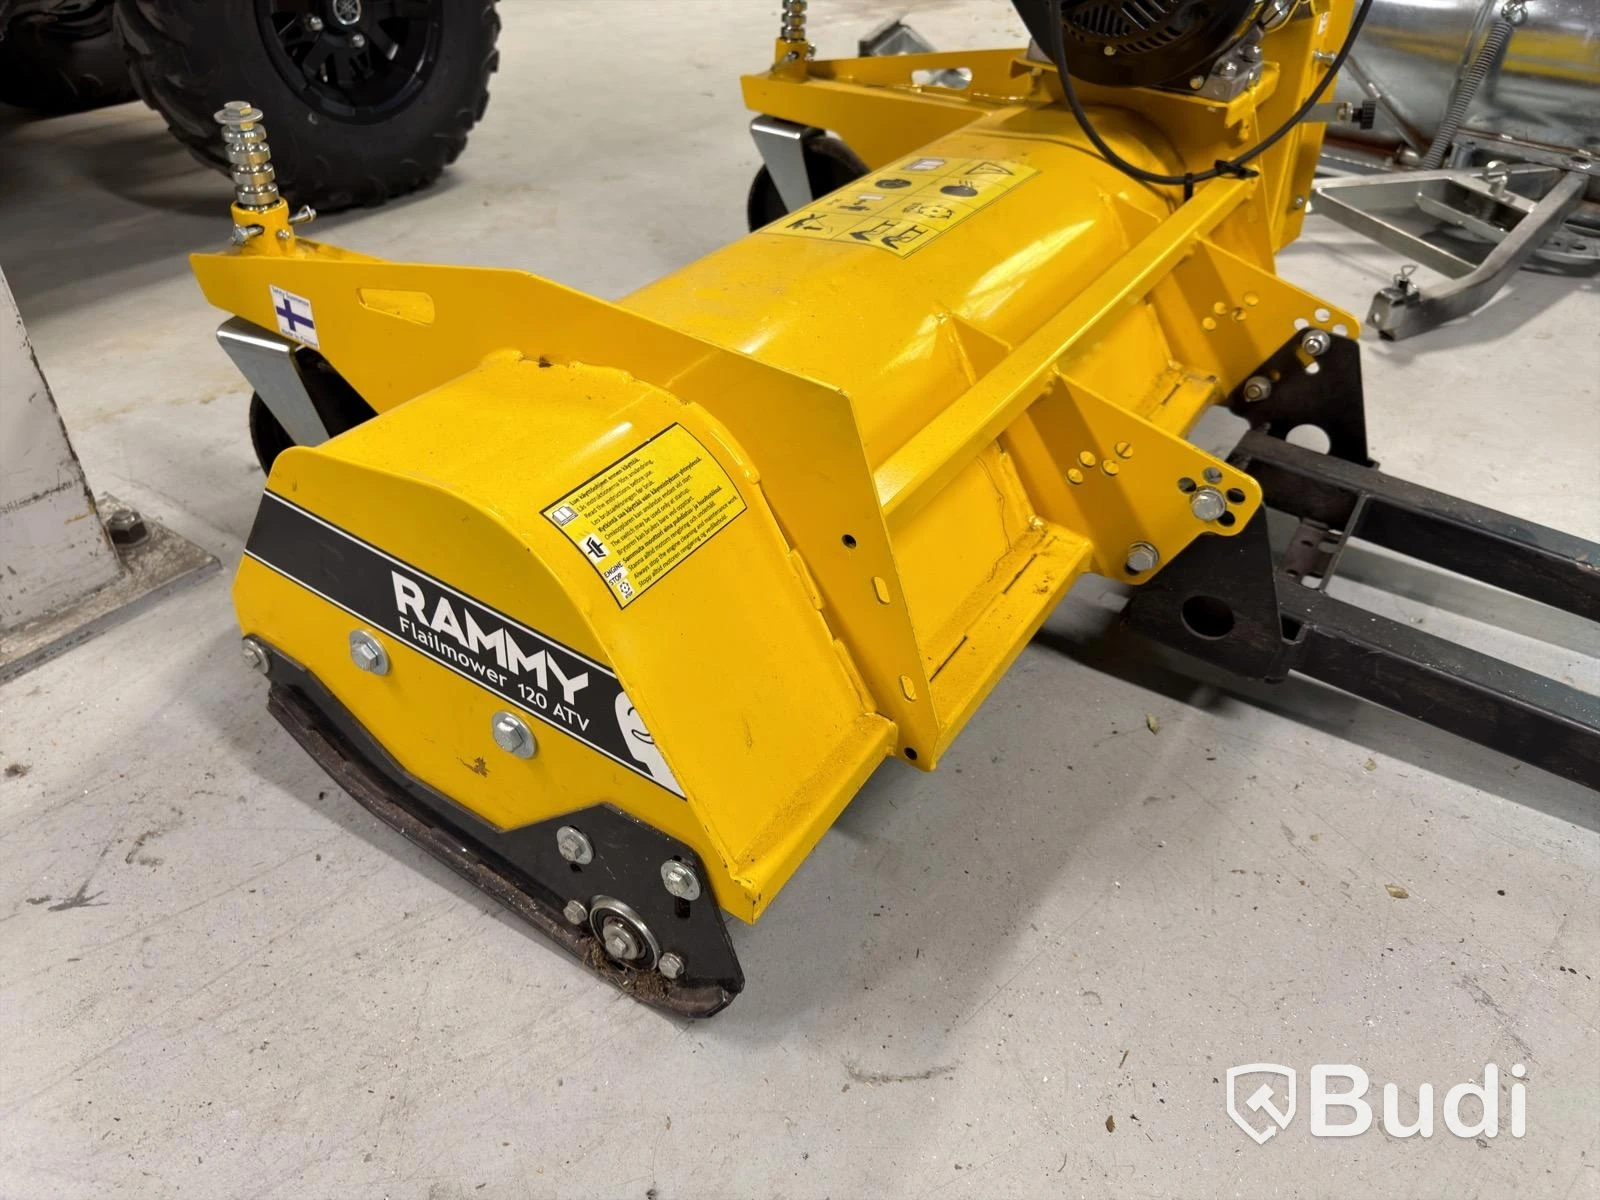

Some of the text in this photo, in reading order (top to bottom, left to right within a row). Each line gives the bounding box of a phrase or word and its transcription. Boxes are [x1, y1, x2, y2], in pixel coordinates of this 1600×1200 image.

[583, 507, 597, 519] Read
[595, 502, 606, 510] the
[604, 484, 631, 504] instructions
[629, 475, 644, 487] before
[633, 509, 643, 518] kan
[610, 538, 620, 547] The
[619, 527, 635, 540] switch
[634, 521, 645, 530] may
[648, 507, 661, 518] used
[659, 501, 670, 511] only
[634, 531, 645, 541] kan
[602, 560, 623, 578] ENGINE
[632, 564, 650, 579] Always
[647, 556, 660, 568] stop
[657, 550, 667, 559] the
[665, 540, 681, 554] engine
[695, 520, 705, 529] and
[608, 572, 624, 585] STOP
[391, 570, 589, 706] RAMMY
[399, 616, 590, 731] Flailmower 120 ATV
